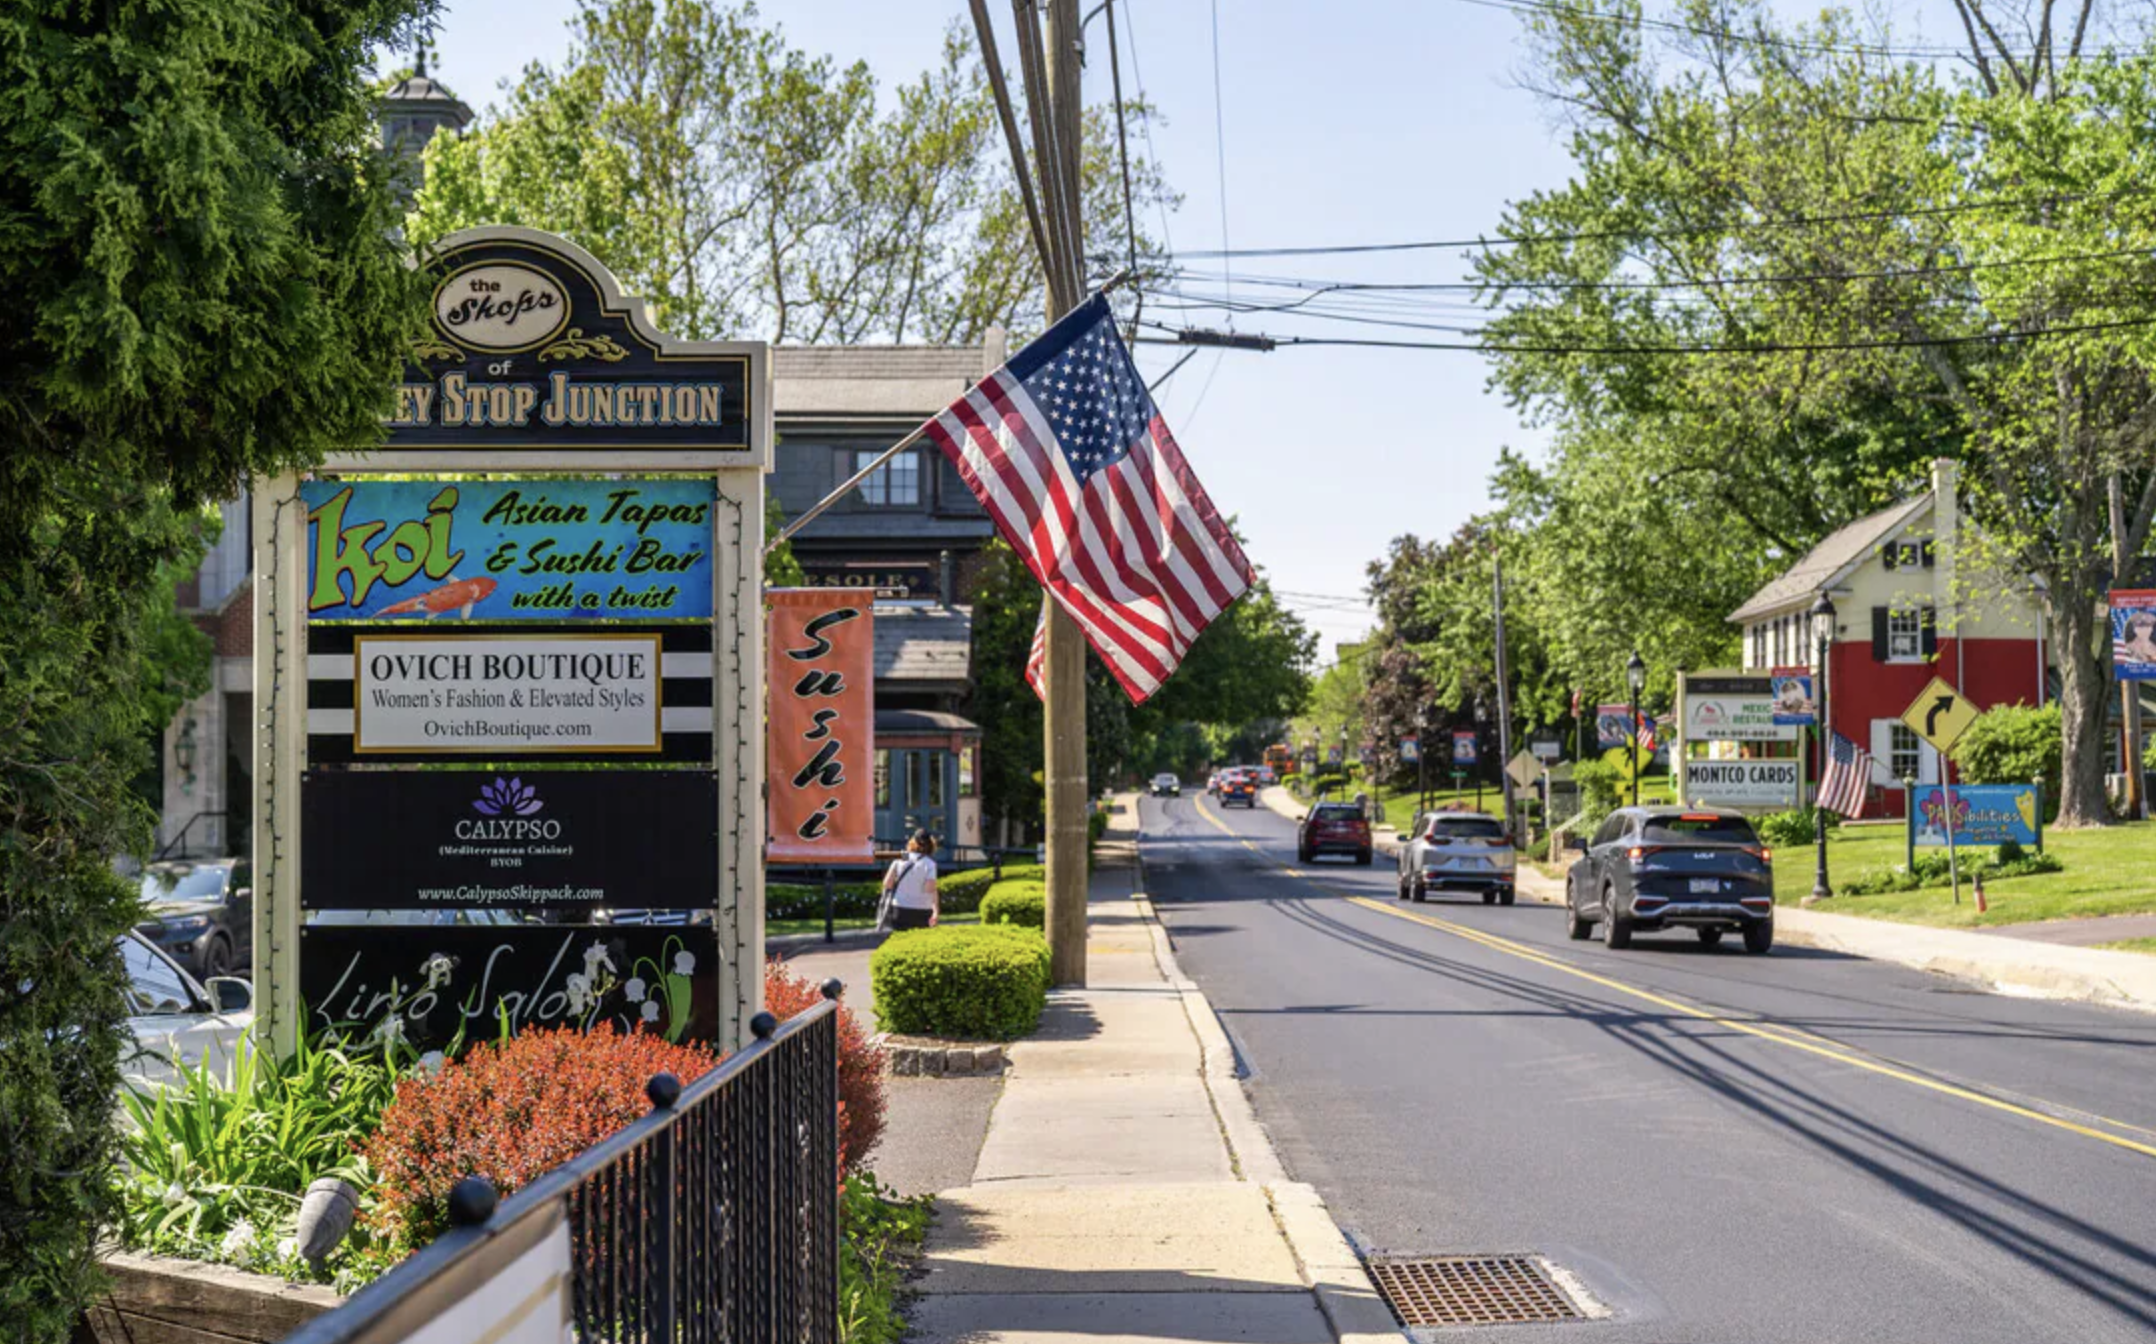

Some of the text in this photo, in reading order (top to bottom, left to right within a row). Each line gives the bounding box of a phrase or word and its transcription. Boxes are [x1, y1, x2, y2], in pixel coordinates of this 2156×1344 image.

[469, 279, 501, 292] the
[447, 289, 558, 326] Shops
[488, 360, 513, 376] of
[379, 383, 434, 426] EY
[482, 489, 709, 537] Asian Tapas
[486, 538, 704, 576] & Sushi Bar
[512, 581, 680, 609] with a twist
[370, 652, 646, 686] OVICH BOUTIQUE
[372, 687, 646, 712] Women's Fashion & Elevated Styles
[424, 719, 592, 741] OvichBoutique.com
[786, 607, 861, 840] Sushi
[1688, 766, 1795, 783] MONTCO CARDS
[455, 819, 561, 840] CALYPSO
[438, 845, 574, 856] (Mediterranean Cuisine)
[490, 858, 523, 867] BYOB
[418, 884, 605, 904] www.CalypsoSkippack.com
